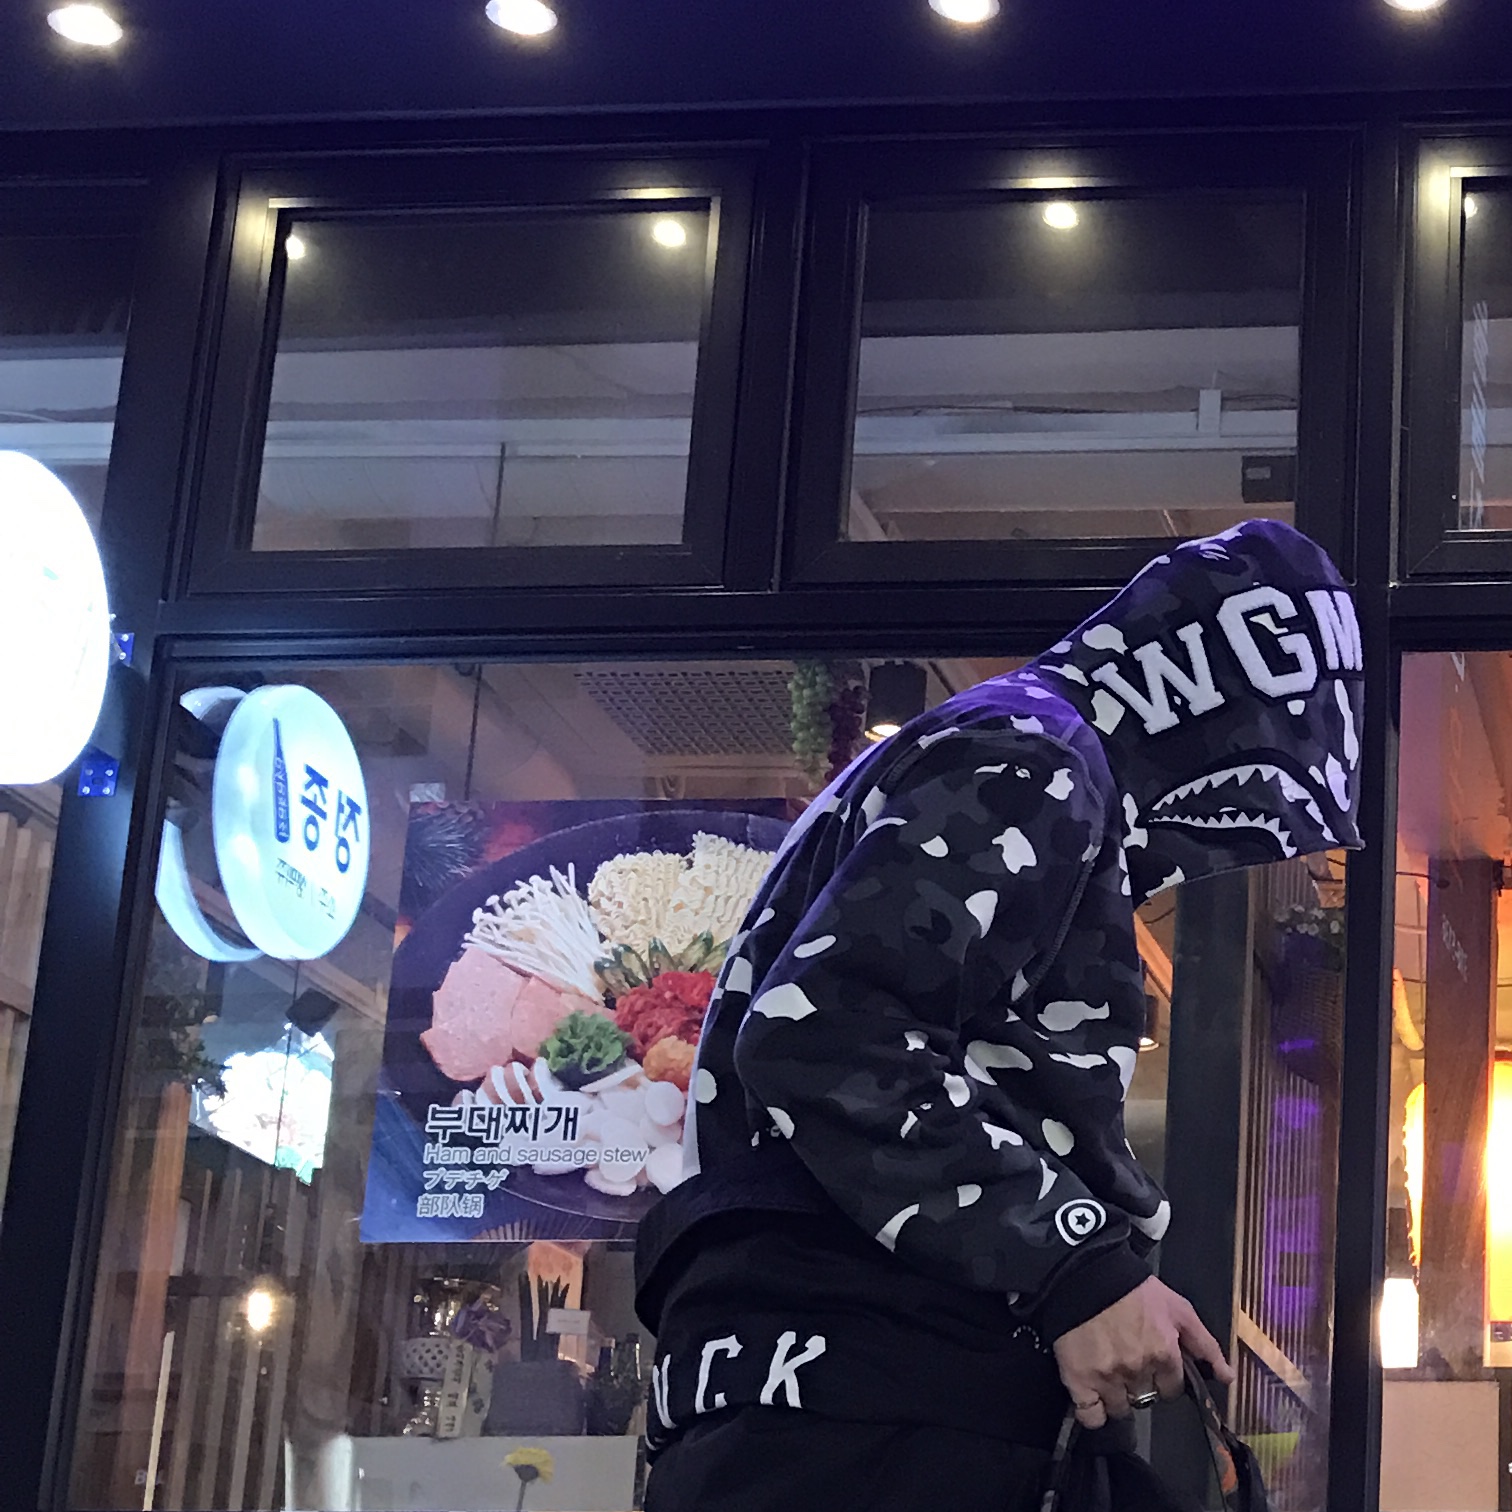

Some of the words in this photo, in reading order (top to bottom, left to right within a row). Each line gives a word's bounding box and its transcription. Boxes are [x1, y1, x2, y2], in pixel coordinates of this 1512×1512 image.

[426, 1105, 580, 1142] 부대찌개
[424, 1146, 471, 1163] Ham
[474, 1147, 510, 1163] and
[517, 1148, 597, 1166] sausage
[602, 1147, 648, 1163] stew
